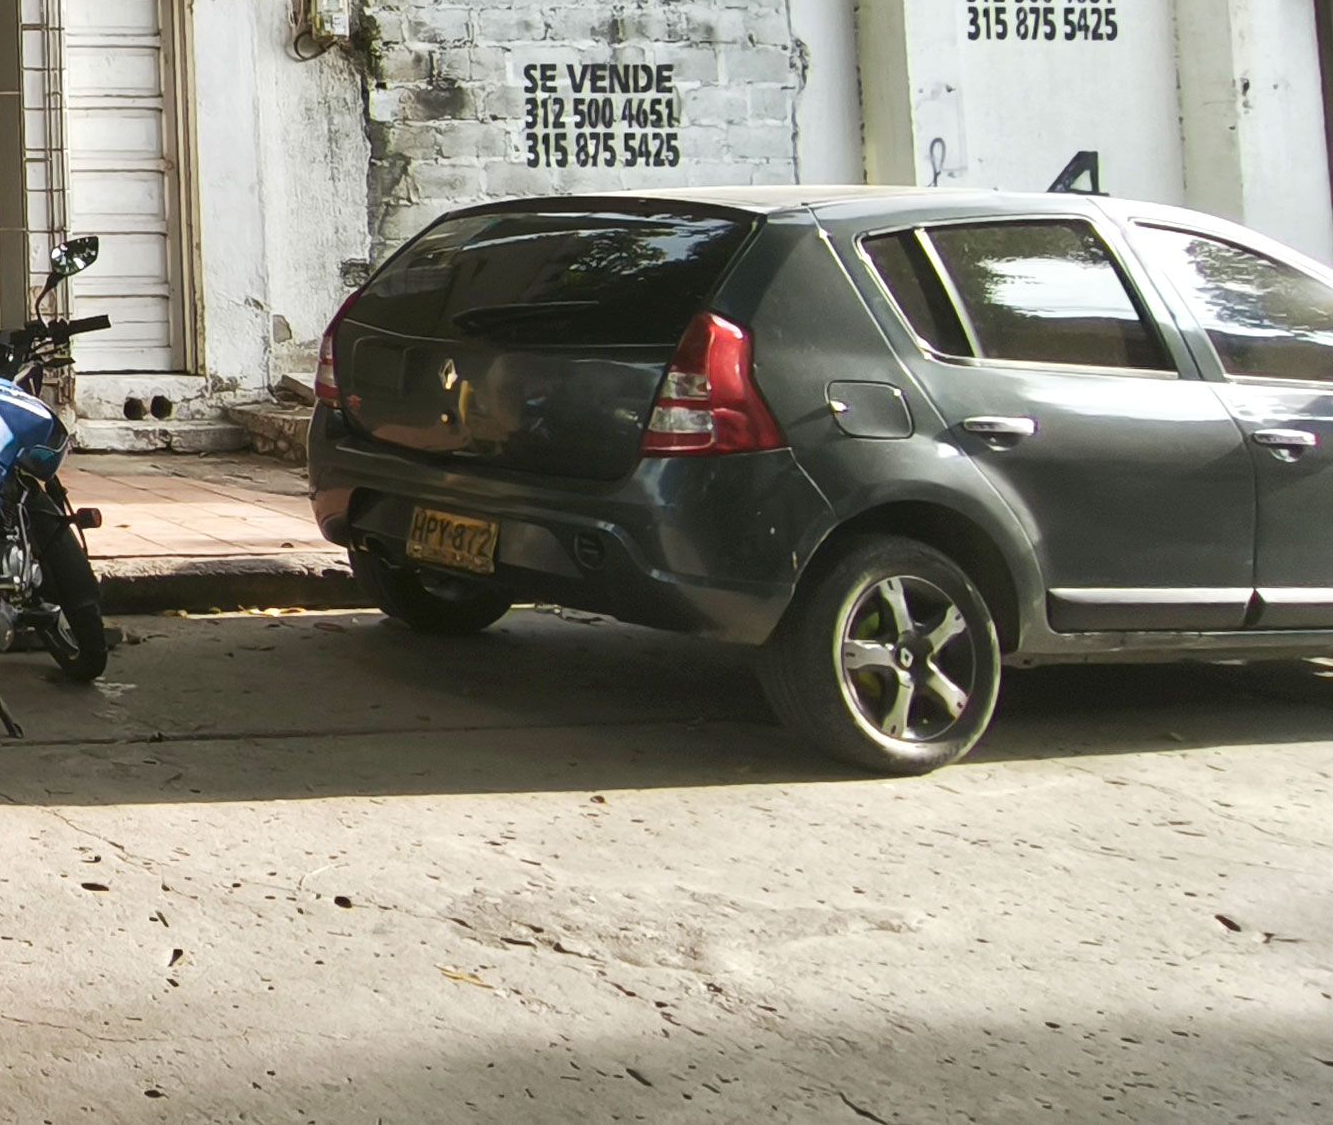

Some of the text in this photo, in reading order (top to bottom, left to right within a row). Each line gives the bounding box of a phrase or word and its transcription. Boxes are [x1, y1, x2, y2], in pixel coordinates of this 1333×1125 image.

[967, 6, 1118, 41] 315 875 5425
[523, 63, 674, 94] SE VENDE
[525, 97, 675, 129] 312 500 4651
[526, 132, 680, 168] 315 875 5425
